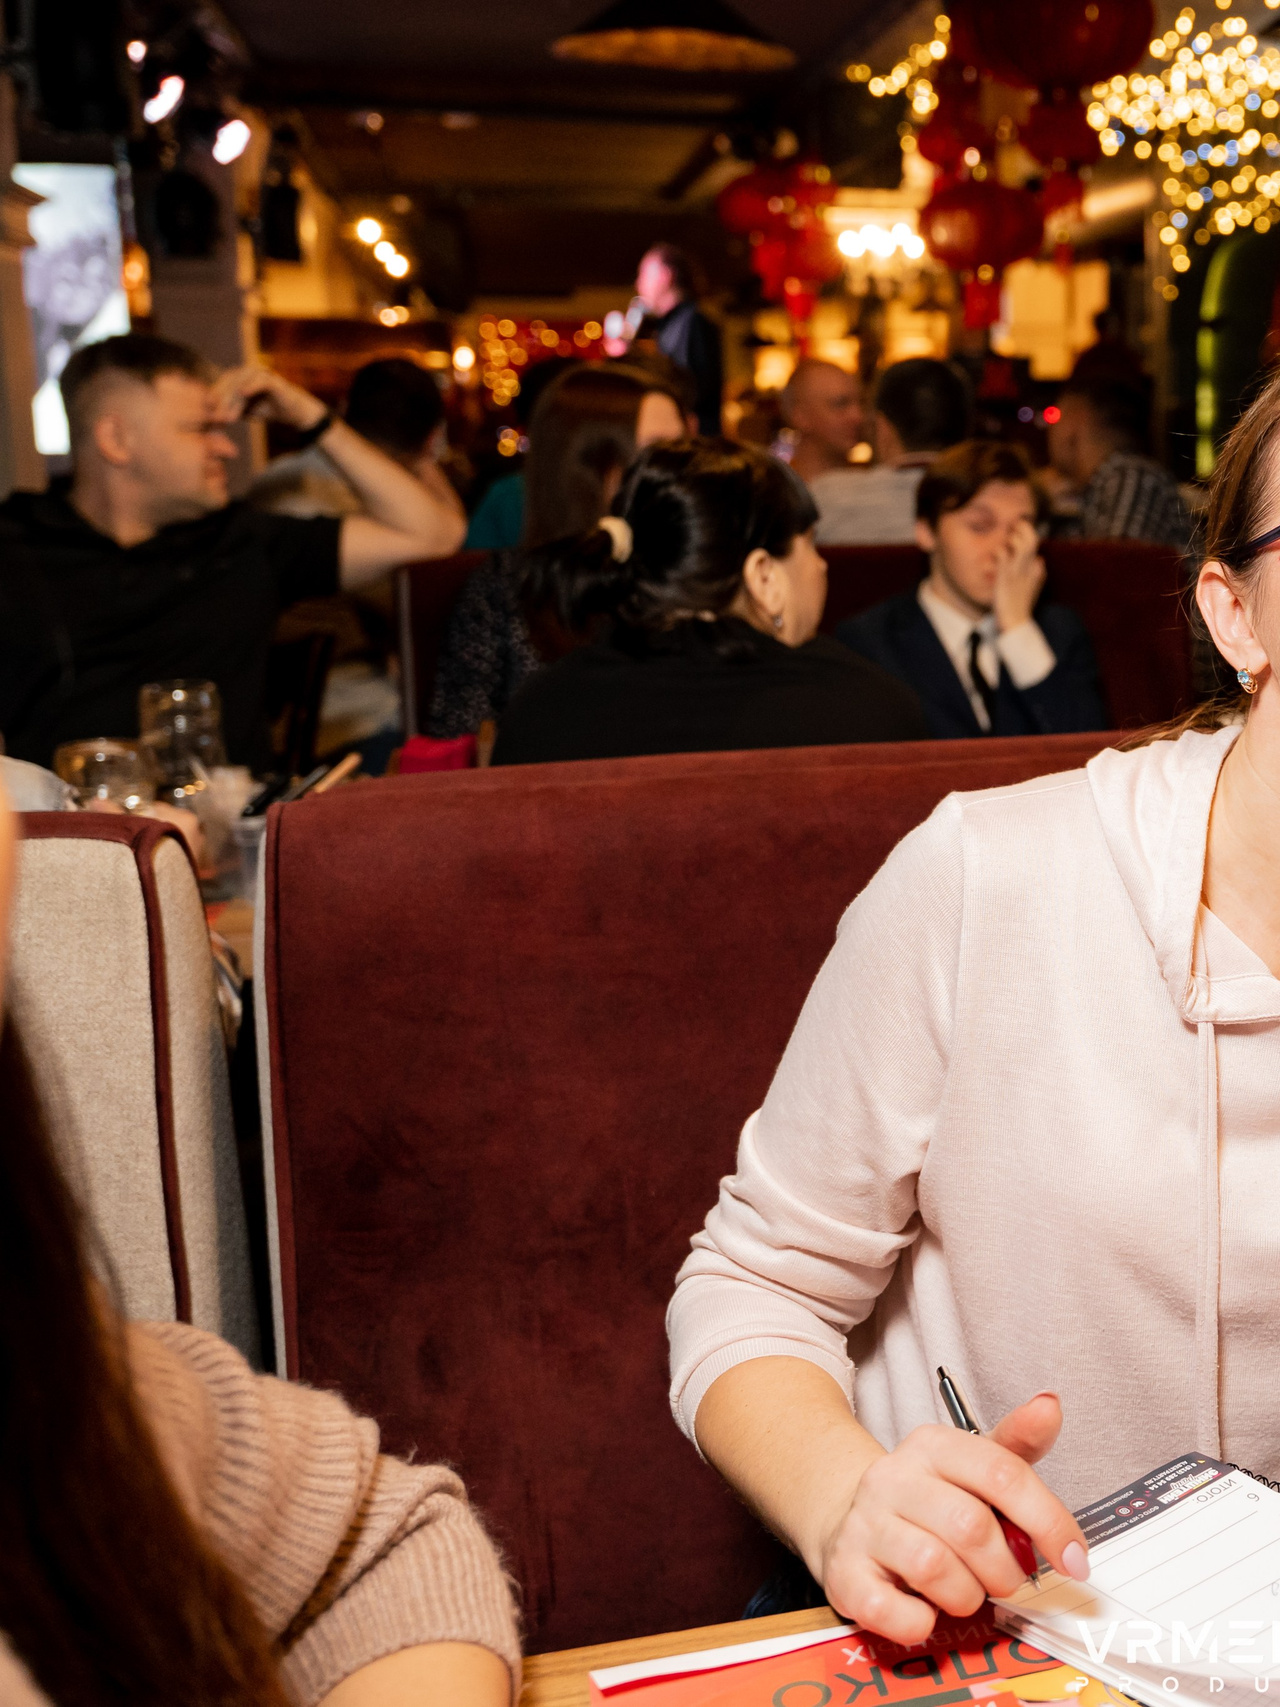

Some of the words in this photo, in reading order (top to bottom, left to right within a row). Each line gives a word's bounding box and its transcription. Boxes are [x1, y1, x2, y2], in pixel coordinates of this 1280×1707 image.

[1192, 1479, 1237, 1504] ИТОГО:
[1247, 1492, 1260, 1502] 6
[772, 1638, 1057, 1707] ОЛЬКО
